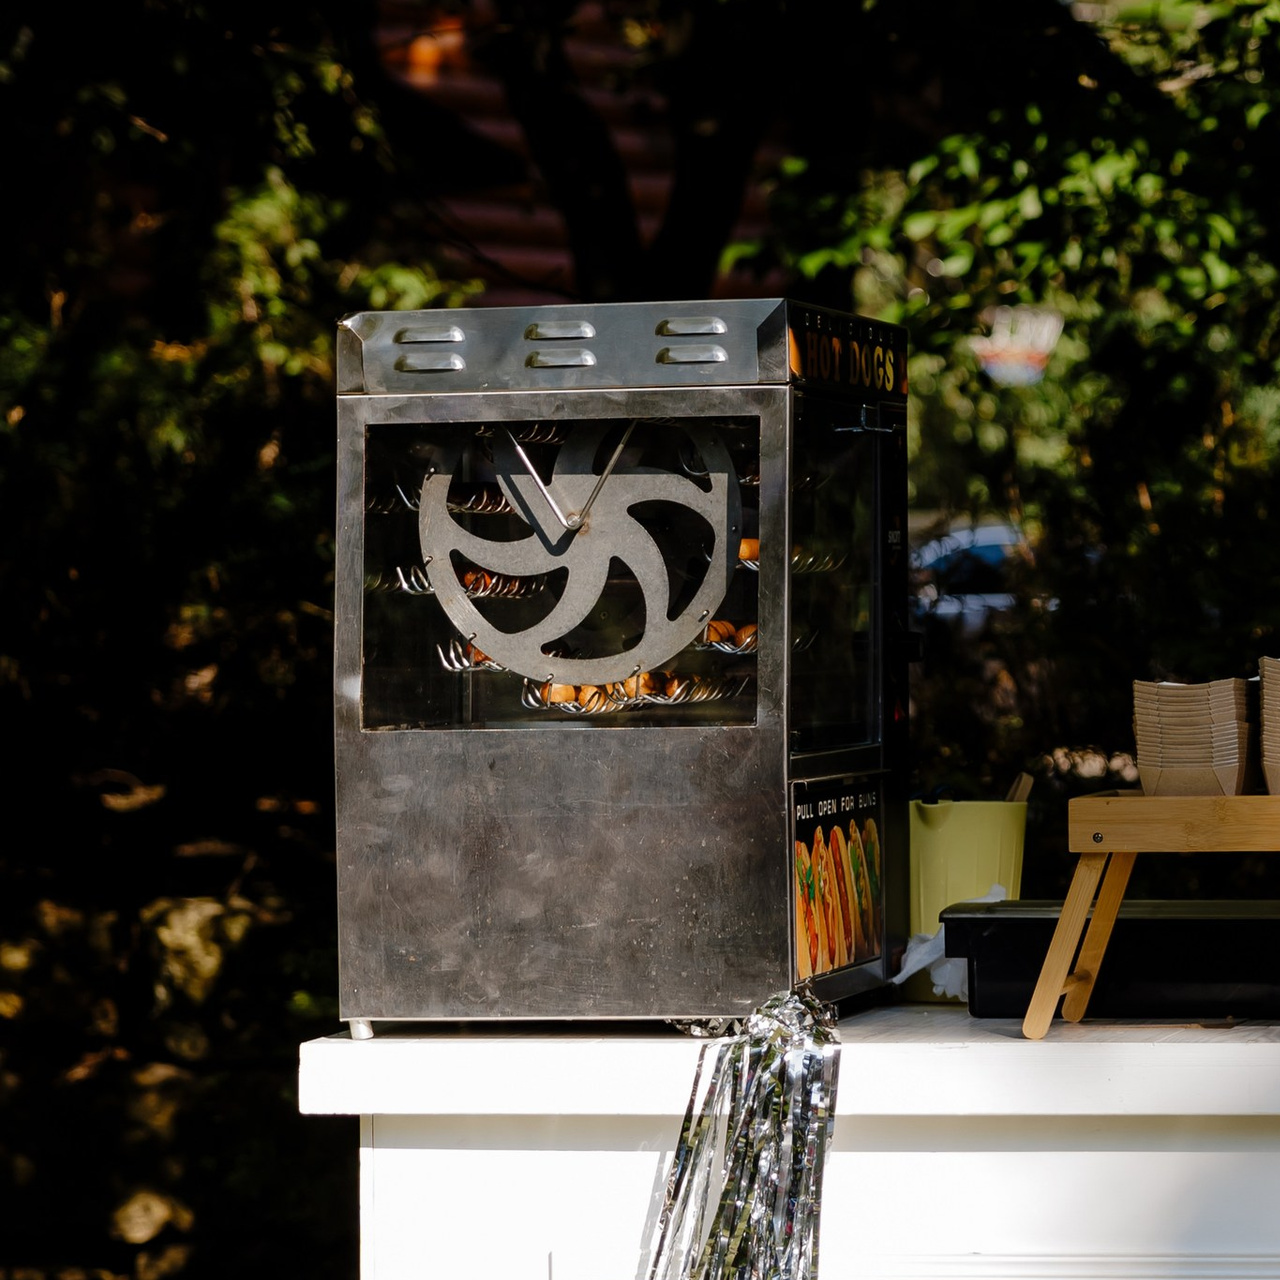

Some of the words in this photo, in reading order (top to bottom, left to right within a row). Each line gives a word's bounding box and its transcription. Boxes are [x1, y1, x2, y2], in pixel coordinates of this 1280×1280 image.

[806, 330, 843, 383] HOT
[849, 339, 895, 392] DOGS
[796, 803, 814, 821] PULL
[818, 798, 837, 817] OPEN
[841, 795, 855, 812] FOR
[858, 791, 877, 808] BUNS
